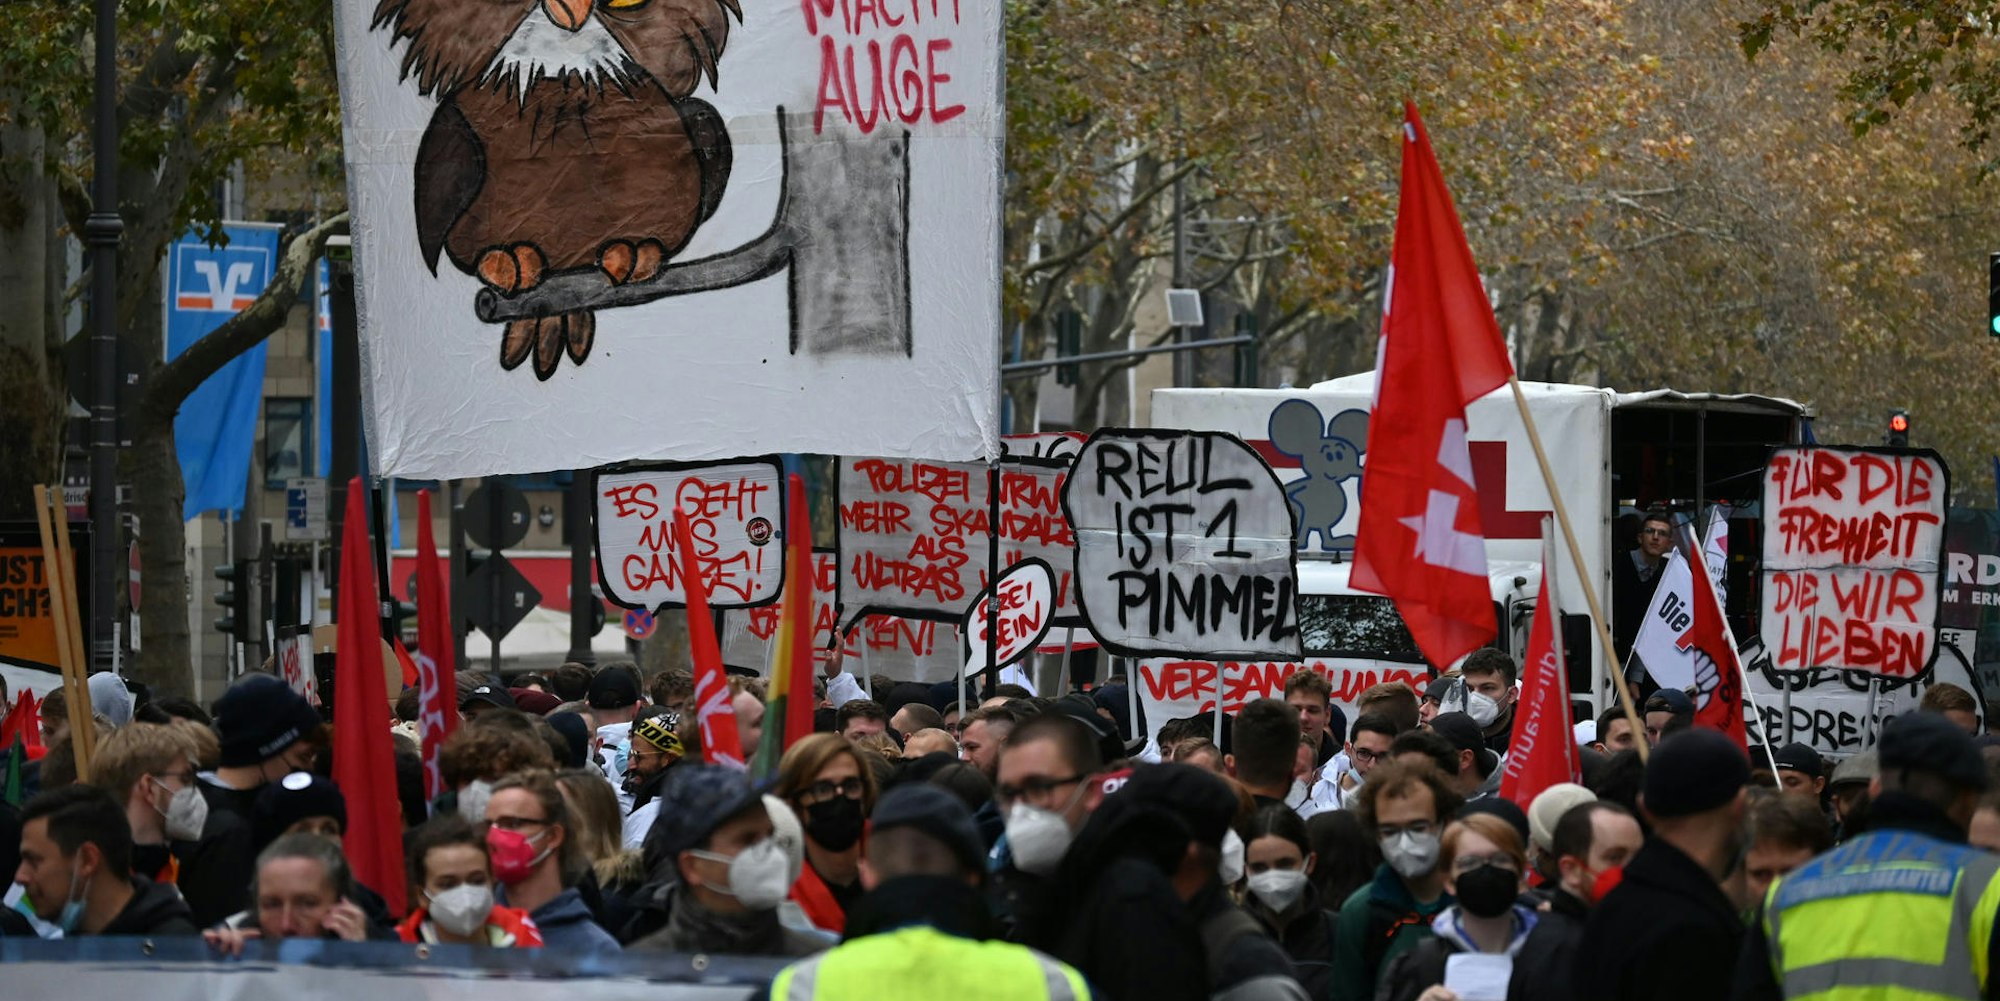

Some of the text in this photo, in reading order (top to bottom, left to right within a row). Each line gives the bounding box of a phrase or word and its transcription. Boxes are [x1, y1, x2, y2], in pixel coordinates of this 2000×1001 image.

[814, 33, 966, 136] AUGE
[853, 459, 970, 504] POLIZEI
[1096, 436, 1253, 500] REUL
[1770, 448, 1933, 507] FÜR DIE
[603, 476, 769, 522] ES GEHT
[839, 501, 912, 535] MEHR
[907, 534, 969, 568] ALS
[1115, 498, 1252, 570] IST 1
[851, 550, 965, 604] ULTRAS
[1107, 567, 1299, 642] PIMMEL
[1772, 572, 1819, 614] DIE
[1831, 568, 1925, 624] WIR
[1657, 591, 1691, 633] Die
[1777, 613, 1926, 676] LIEBEN
